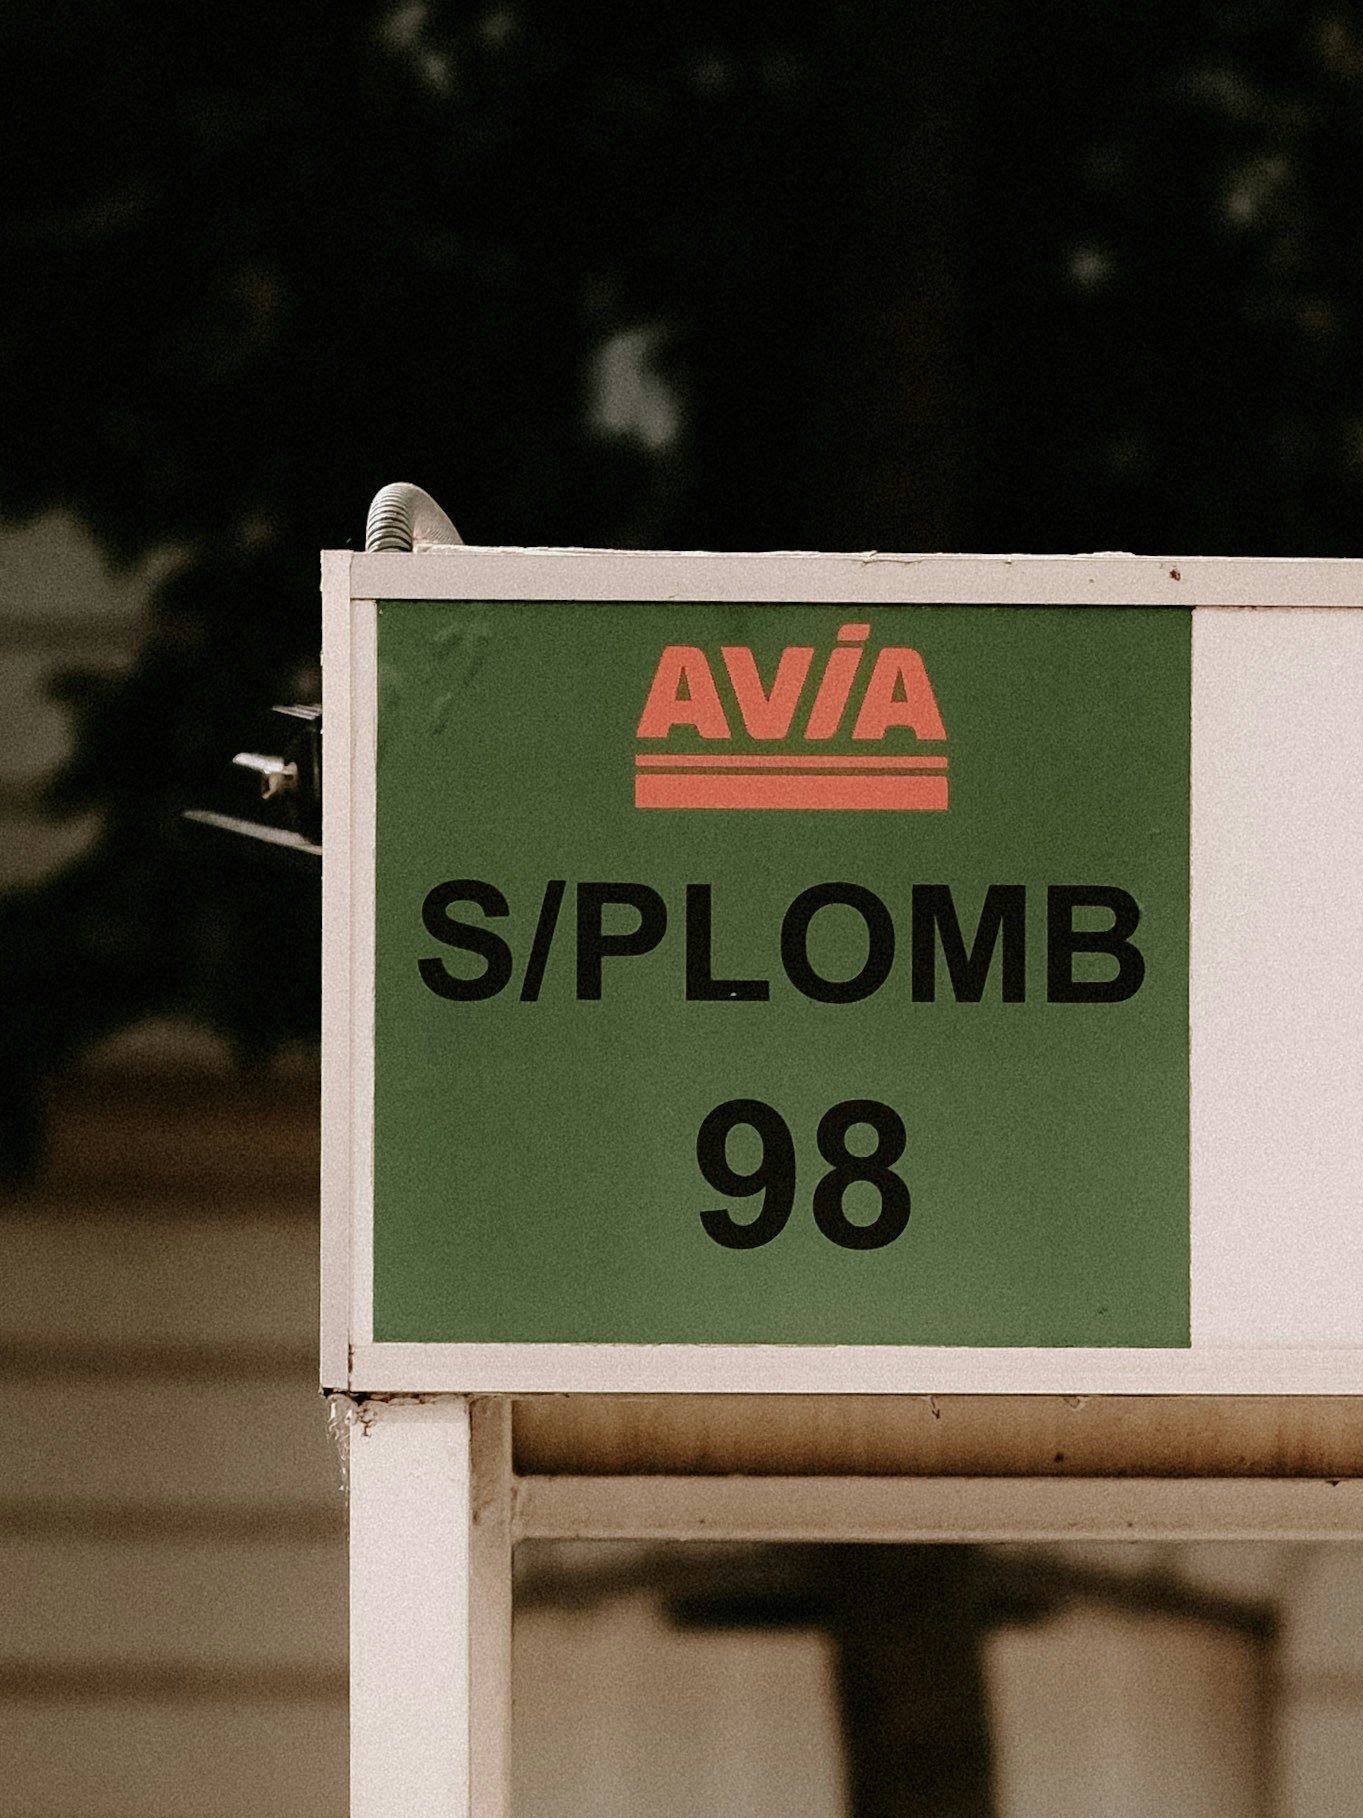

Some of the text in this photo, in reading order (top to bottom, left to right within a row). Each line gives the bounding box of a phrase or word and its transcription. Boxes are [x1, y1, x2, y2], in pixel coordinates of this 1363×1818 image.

[635, 623, 947, 741] AVIA
[417, 879, 1146, 1003] S/PLOMB
[696, 1098, 912, 1250] 98
